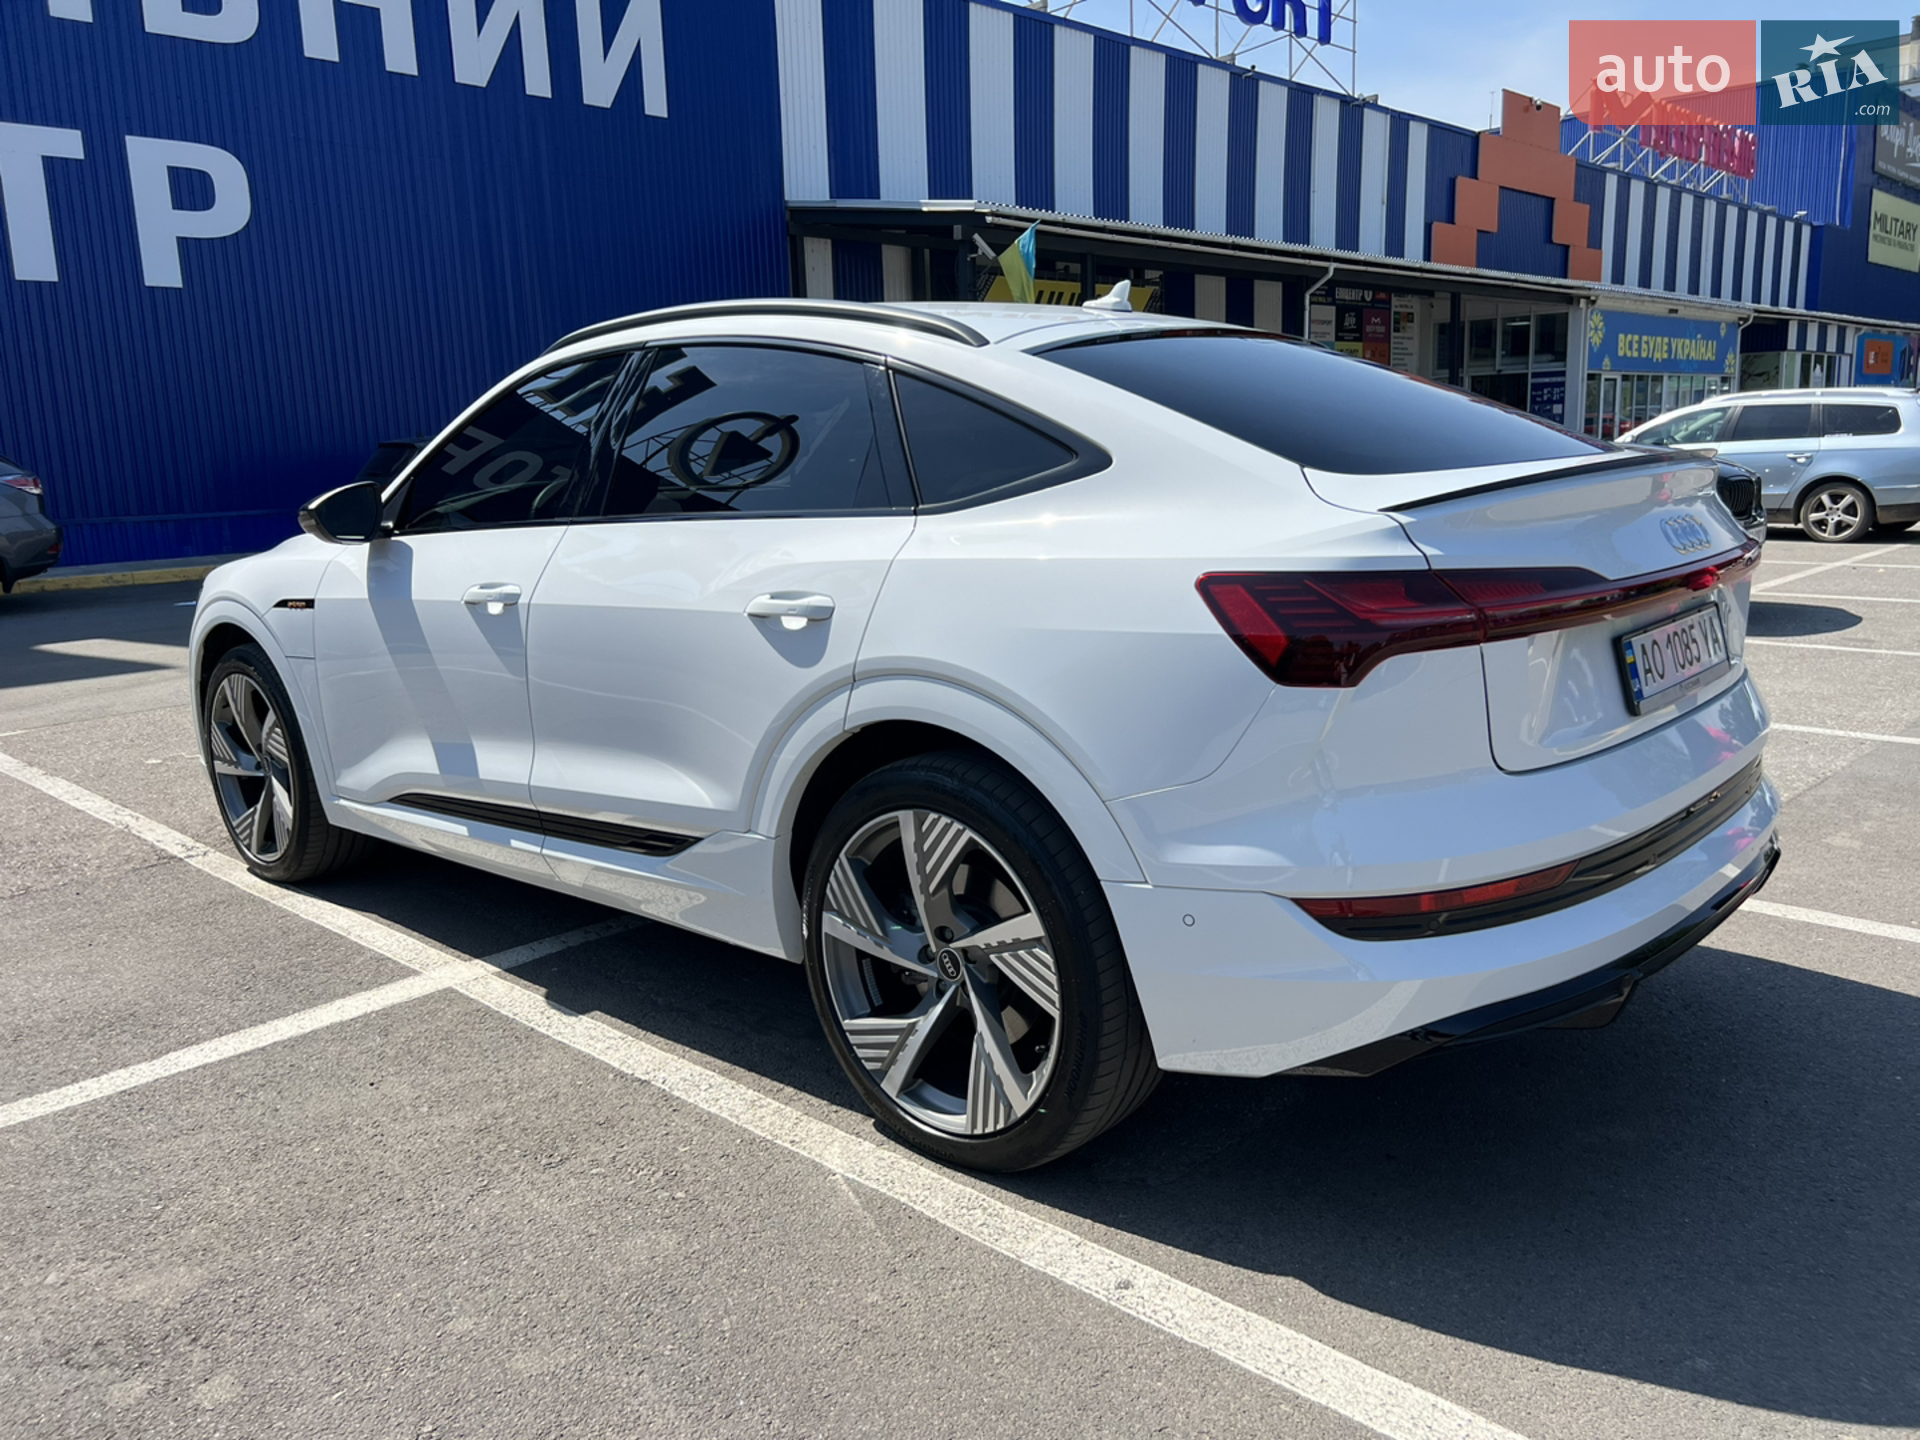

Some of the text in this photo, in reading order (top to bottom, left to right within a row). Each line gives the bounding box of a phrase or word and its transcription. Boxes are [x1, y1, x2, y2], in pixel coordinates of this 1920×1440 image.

[1873, 210, 1918, 242] MILITARY
[1618, 333, 1717, 363] ВСЕ БУДЕ УКРАЇНА!
[1641, 616, 1722, 687] AO 1085 YA
